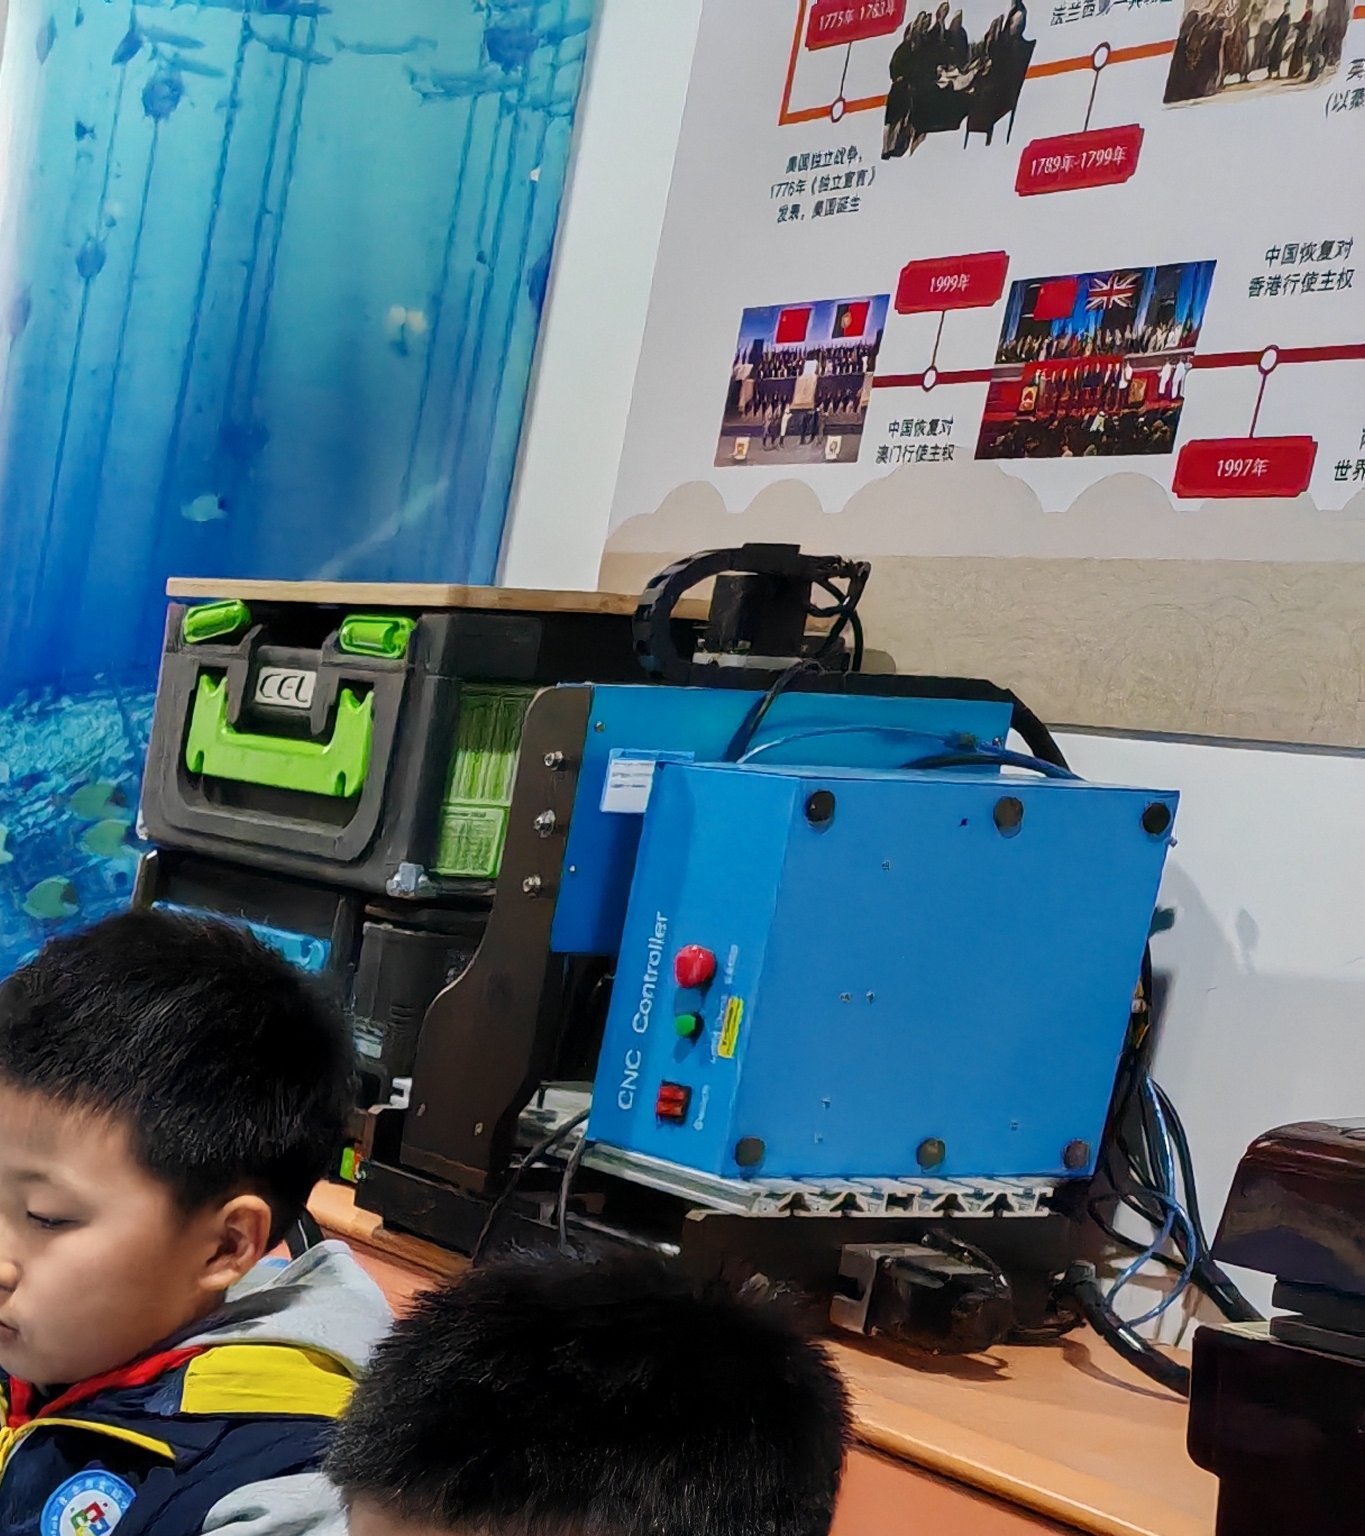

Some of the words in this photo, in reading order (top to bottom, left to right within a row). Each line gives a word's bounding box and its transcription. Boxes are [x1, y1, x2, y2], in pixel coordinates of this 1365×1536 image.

[1030, 145, 1128, 177] 1789年-1799年
[1264, 237, 1354, 269] 中国恢复对
[929, 273, 972, 293] 1999年
[1248, 267, 1356, 299] 香港行使主权
[888, 415, 955, 438] 中国恢复对
[875, 443, 956, 465] 澳门行使主权
[1216, 457, 1270, 478] 1997年
[617, 1048, 642, 1111] CNC
[631, 910, 669, 1034] Controller
